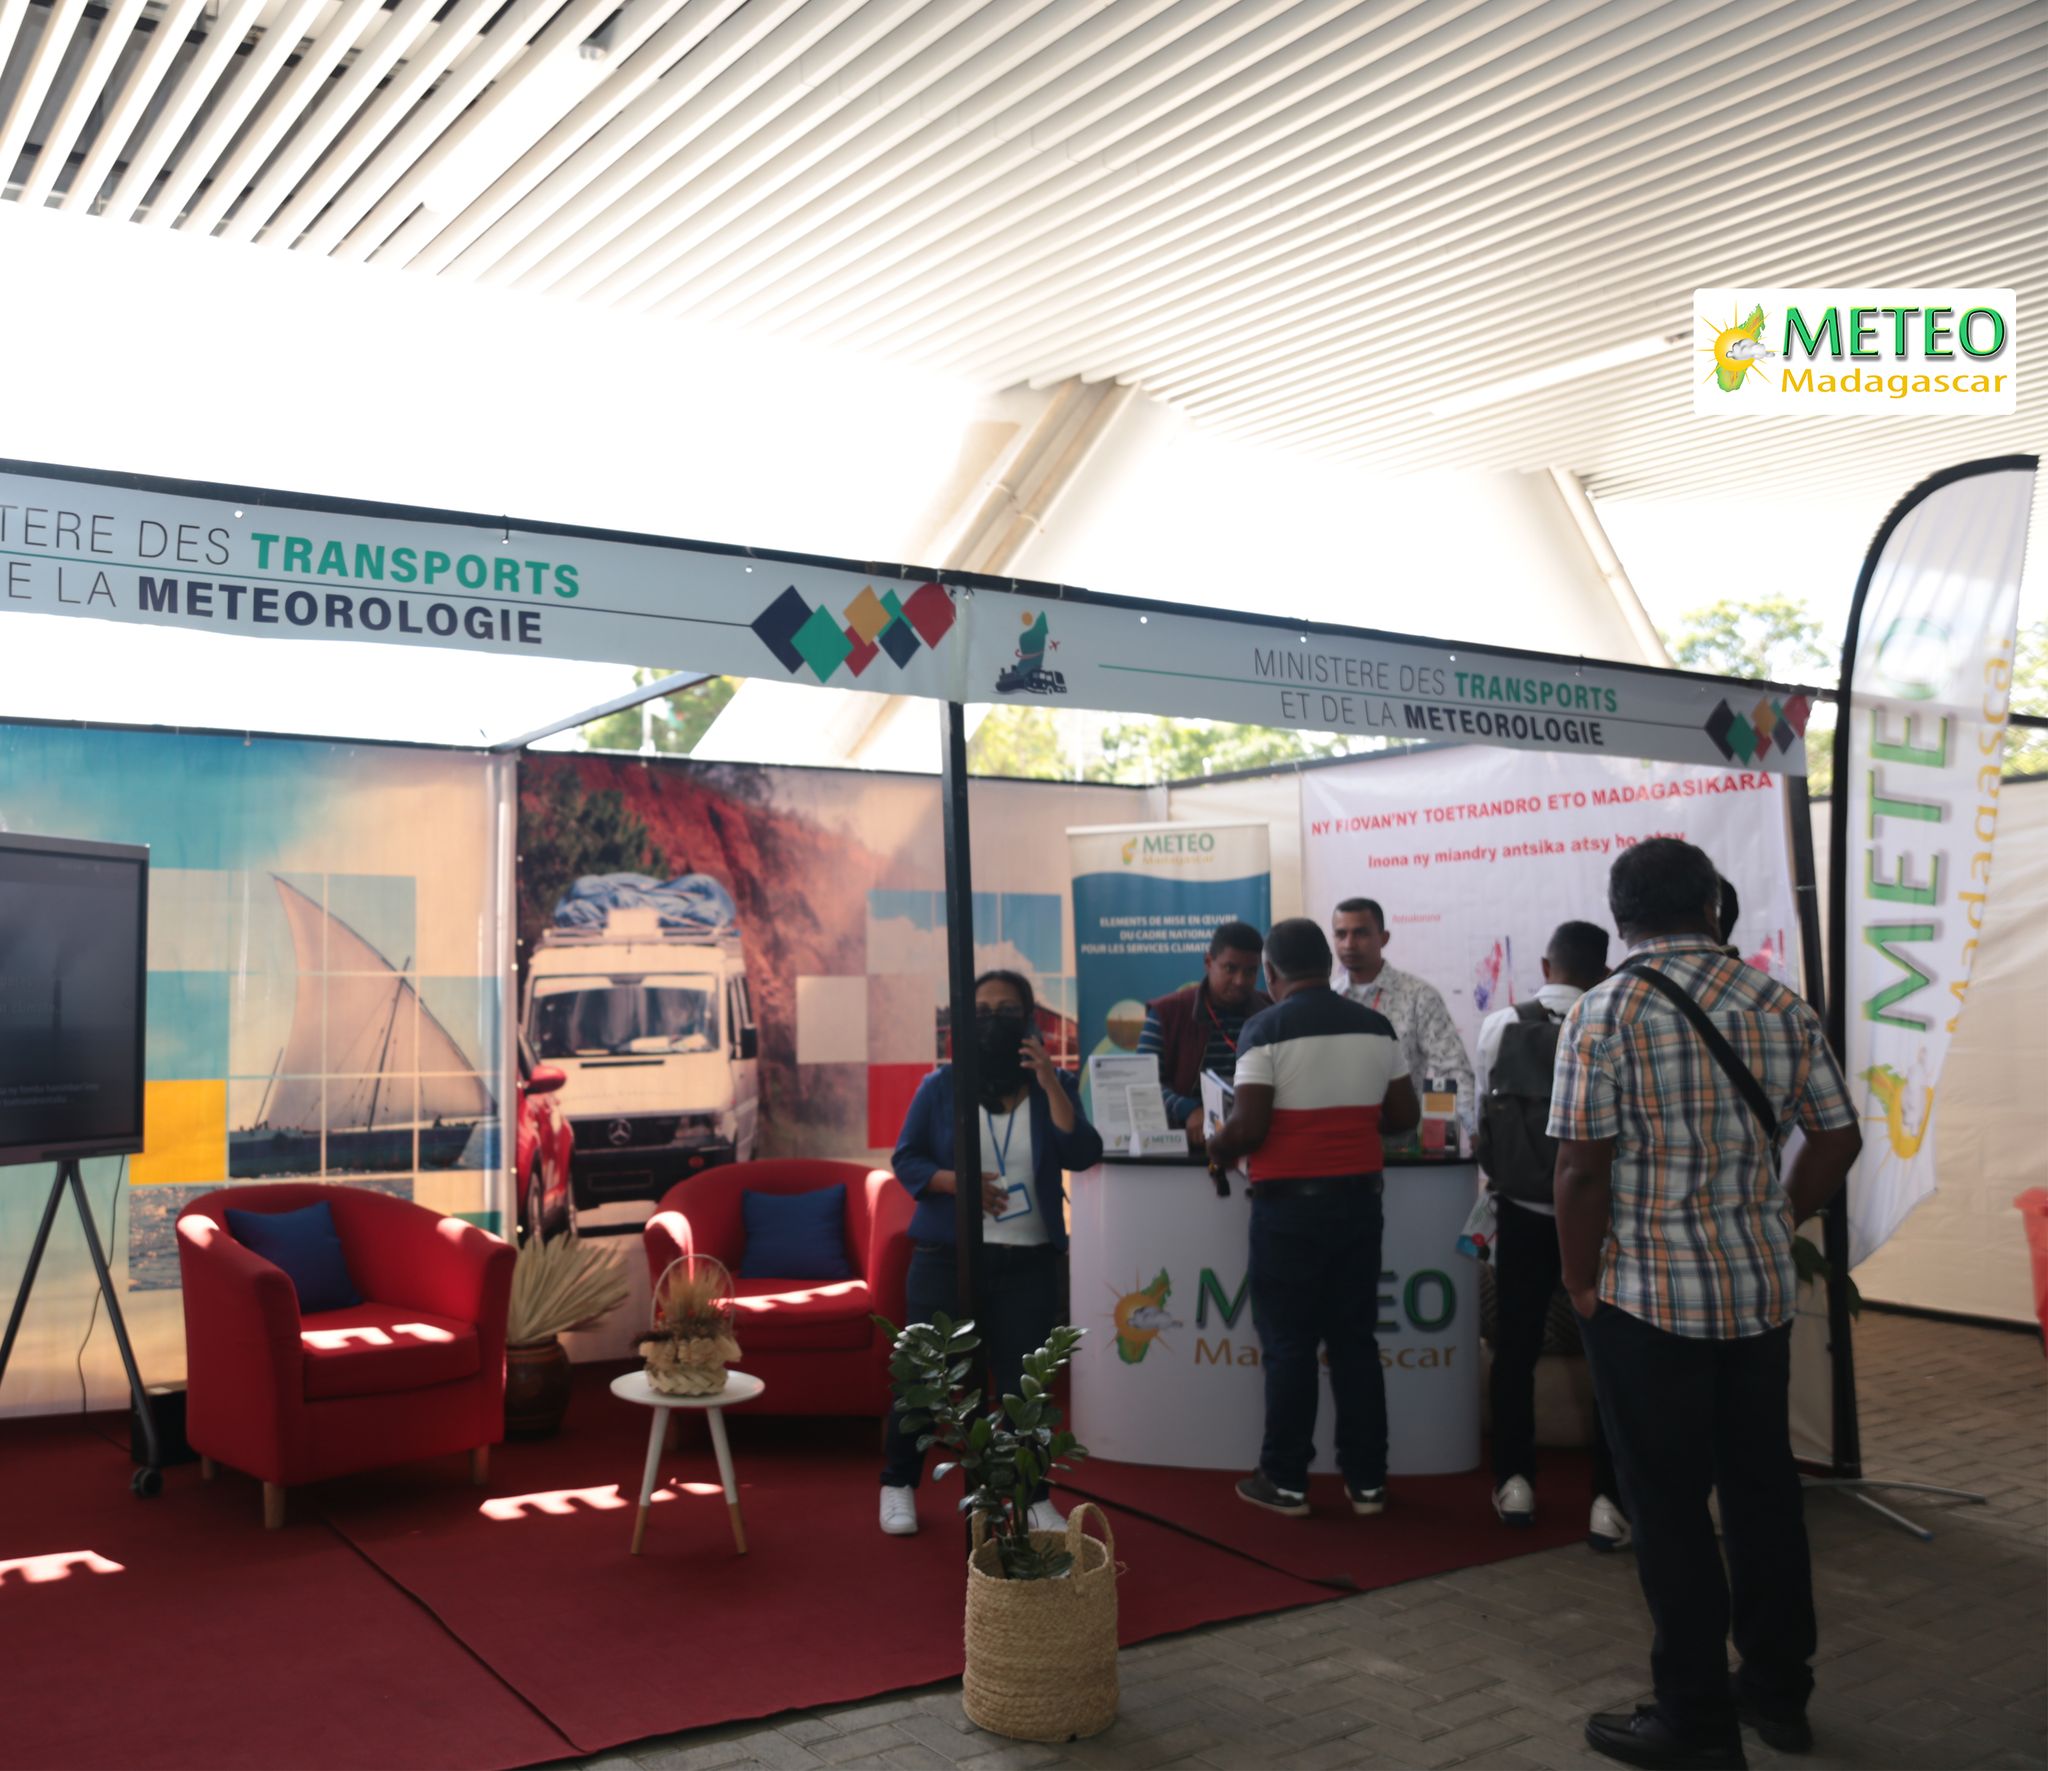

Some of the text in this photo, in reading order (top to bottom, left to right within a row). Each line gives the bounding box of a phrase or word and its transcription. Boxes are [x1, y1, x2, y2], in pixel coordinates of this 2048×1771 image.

[139, 520, 229, 565] DES
[251, 532, 580, 598] TRANSPORTS
[58, 567, 116, 607] LA
[139, 575, 543, 644] METEOROLOGIE
[1254, 647, 1618, 713] MINISTERE DES TRANSPORTS
[1281, 690, 1605, 746] ET DE LA METEOROLOGIE
[1311, 820, 1331, 835] NY
[1424, 797, 1541, 824] TOETRANDRO
[1548, 792, 1587, 811] ETO
[1593, 771, 1774, 806] MADAGASIKARA
[1862, 616, 1952, 1034] METEO
[1142, 833, 1215, 854] METEO
[1368, 854, 1409, 869] Inona
[1413, 853, 1430, 868] ny
[1435, 844, 1497, 863] miandry
[1502, 838, 1565, 858] antsika
[1571, 835, 1610, 854] atsy
[1195, 1267, 1457, 1333] MEO
